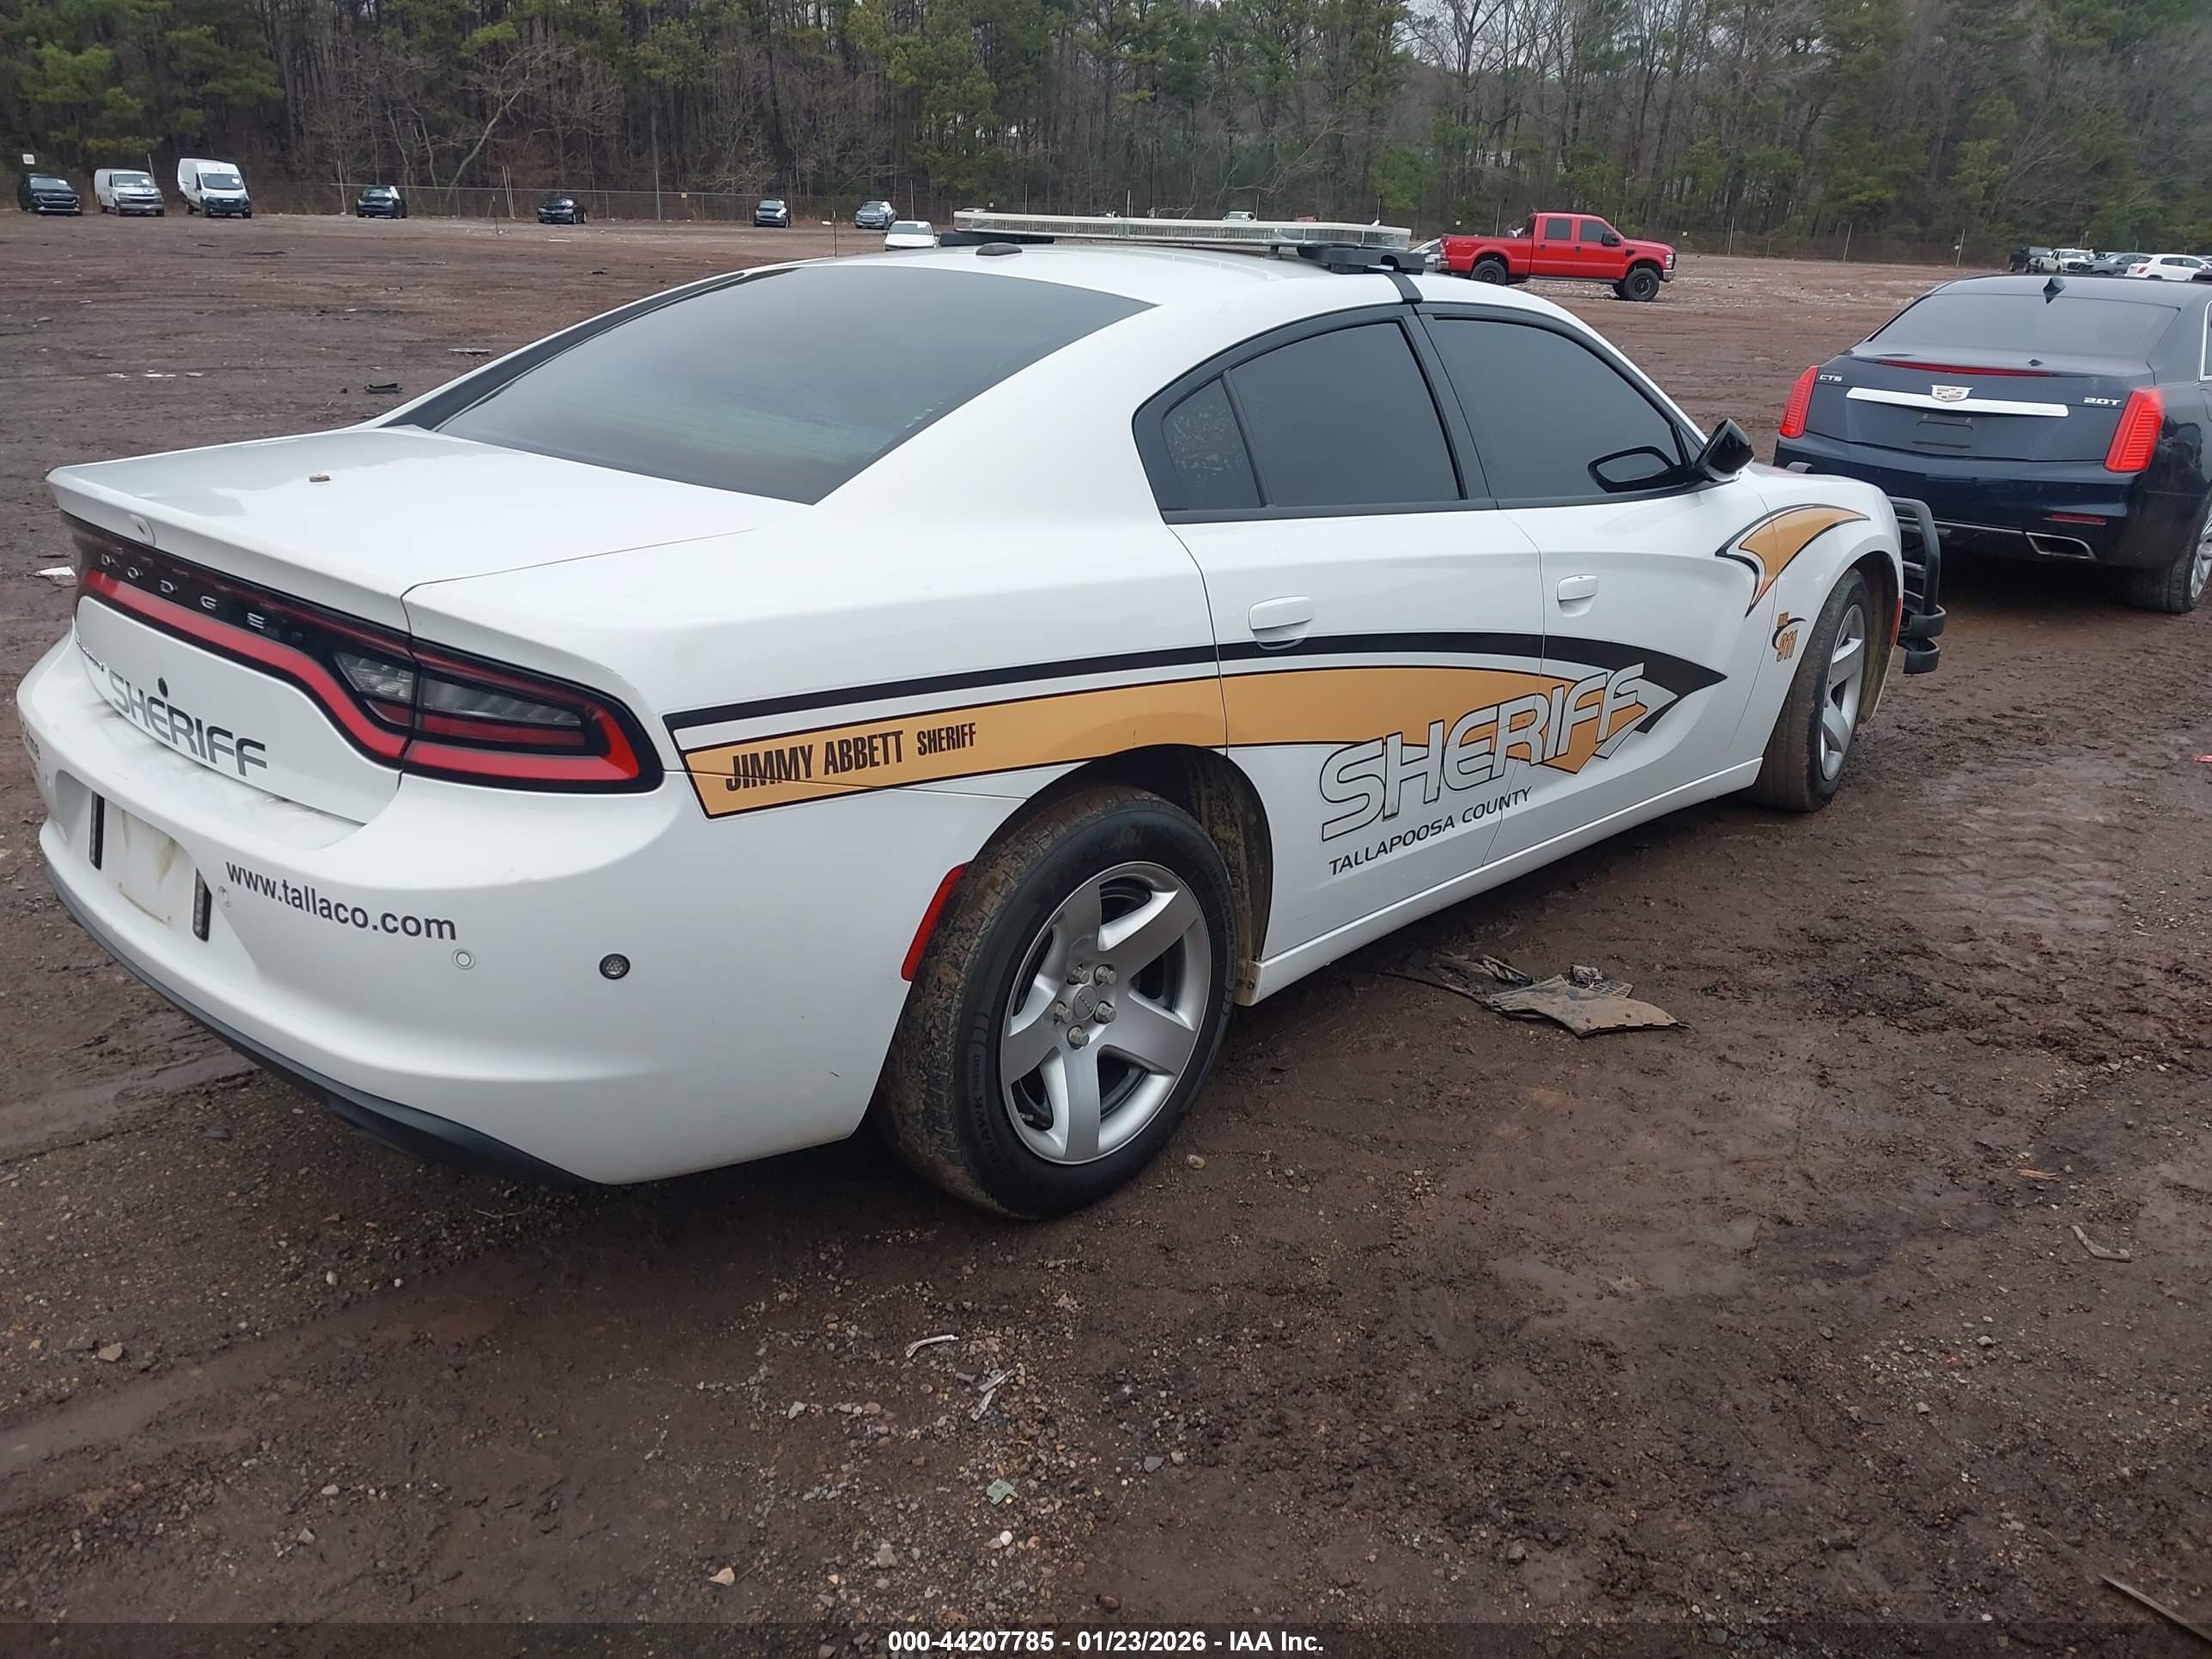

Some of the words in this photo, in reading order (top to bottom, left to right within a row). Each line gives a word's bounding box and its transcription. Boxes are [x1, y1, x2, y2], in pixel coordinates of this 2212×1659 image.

[100, 552, 266, 630] DODGE
[108, 669, 268, 777] SHERIFF
[726, 744, 814, 792] JIMMY
[823, 730, 904, 775] ABBETT
[916, 722, 976, 757] SHERIFF
[1319, 662, 1645, 843] SHERIFF
[1328, 815, 1455, 876] TALLAPOOSA
[1462, 786, 1533, 824] COUNTY
[226, 861, 457, 941] www.tallaco.com
